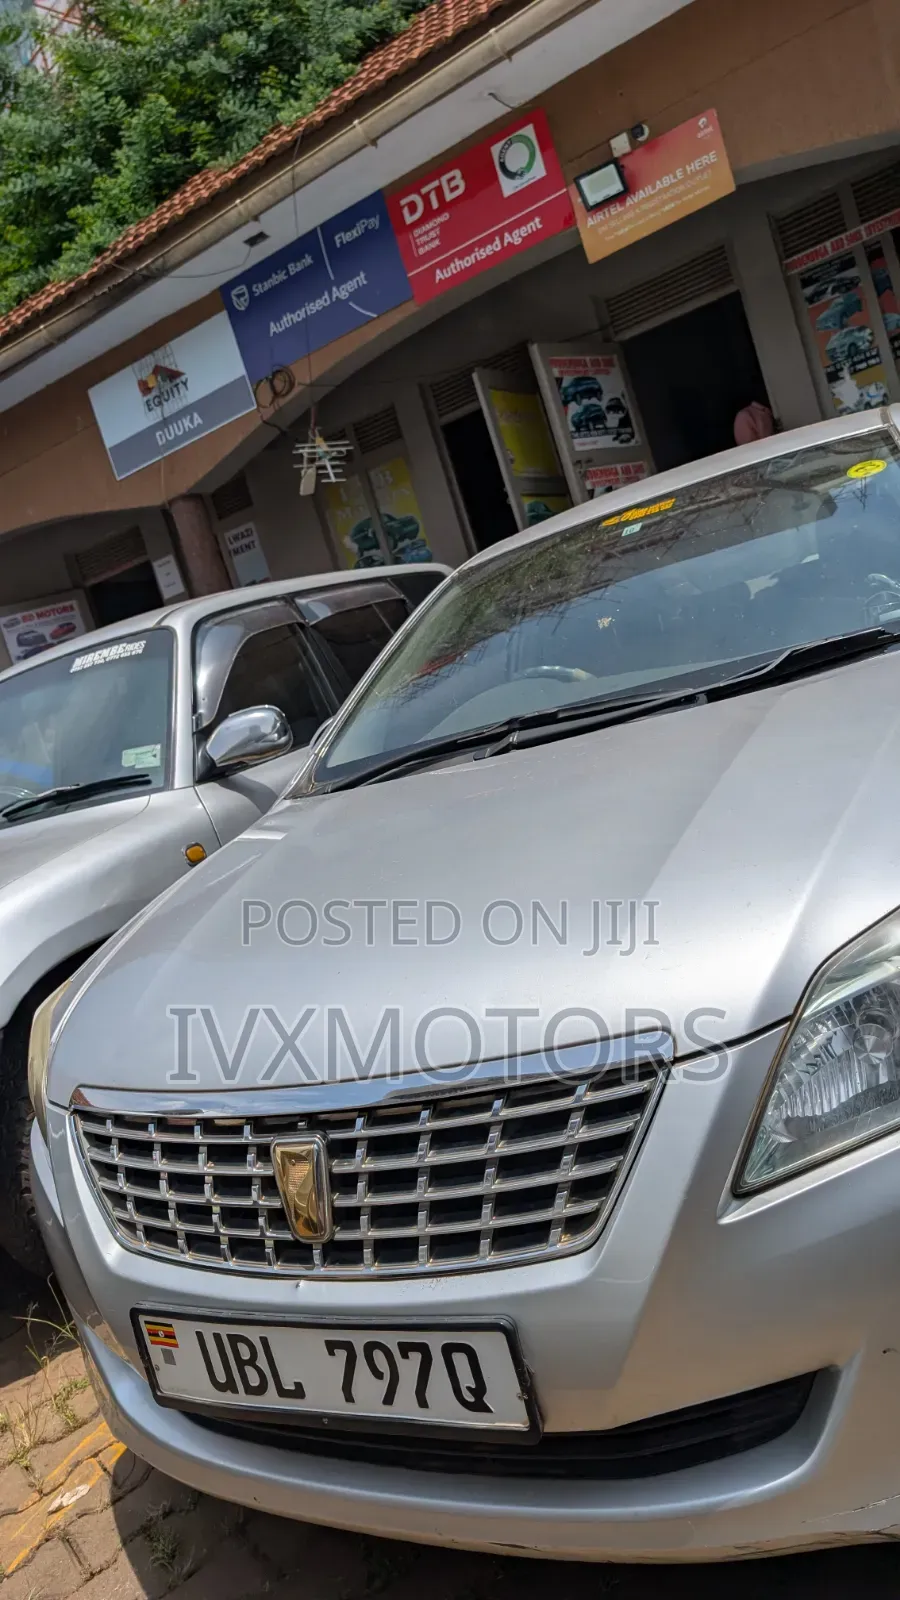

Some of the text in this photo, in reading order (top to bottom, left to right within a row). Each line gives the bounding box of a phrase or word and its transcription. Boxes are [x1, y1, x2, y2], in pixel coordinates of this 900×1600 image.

[400, 169, 466, 225] DTB
[587, 202, 625, 228] AIRTEL
[625, 168, 685, 207] AVAILABLE
[686, 151, 718, 175] HERE
[333, 214, 381, 249] FlexiPay
[413, 212, 450, 238] DIAMOND
[415, 228, 441, 248] TRUST
[418, 238, 442, 256] BANK
[434, 216, 544, 284] Authorised Agent
[251, 254, 314, 297] Stanbic Bank
[268, 271, 369, 337] Authorised Agent
[145, 378, 190, 412] EQUITY
[156, 411, 204, 446] DUUKA
[194, 1330, 494, 1414] UBL 797Q
